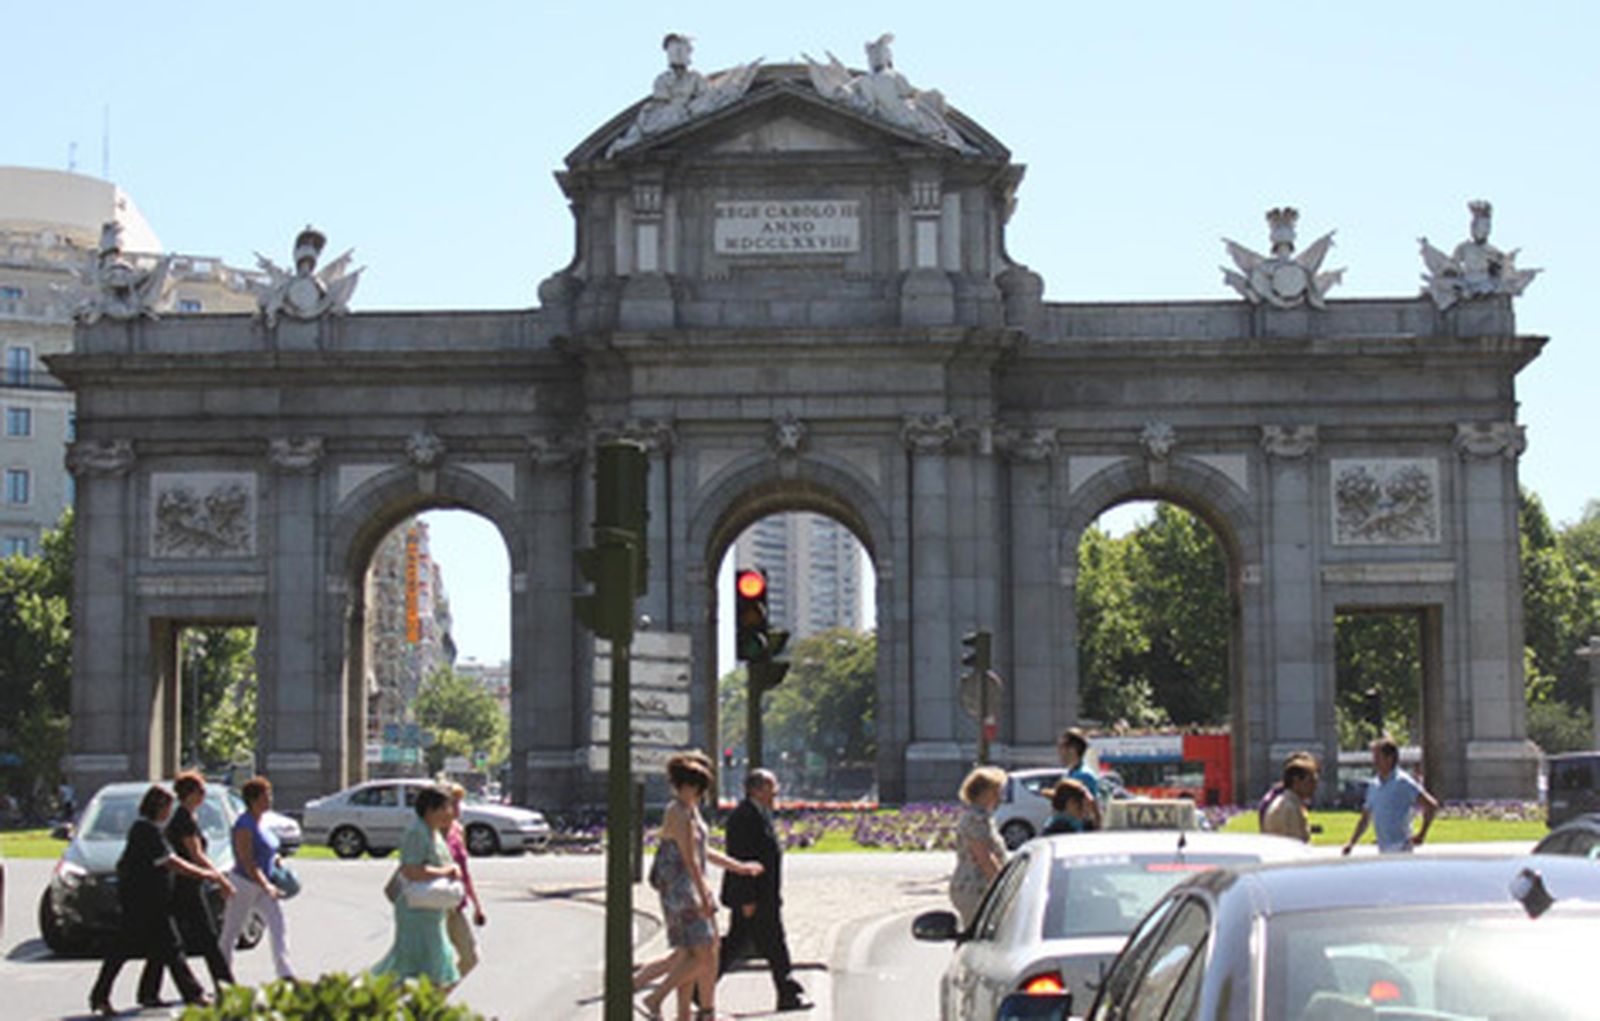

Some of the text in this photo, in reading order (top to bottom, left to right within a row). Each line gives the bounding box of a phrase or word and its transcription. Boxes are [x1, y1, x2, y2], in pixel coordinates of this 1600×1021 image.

[764, 204, 837, 218] CAROLO
[762, 221, 816, 234] ANNO
[1130, 807, 1176, 824] TAXI
